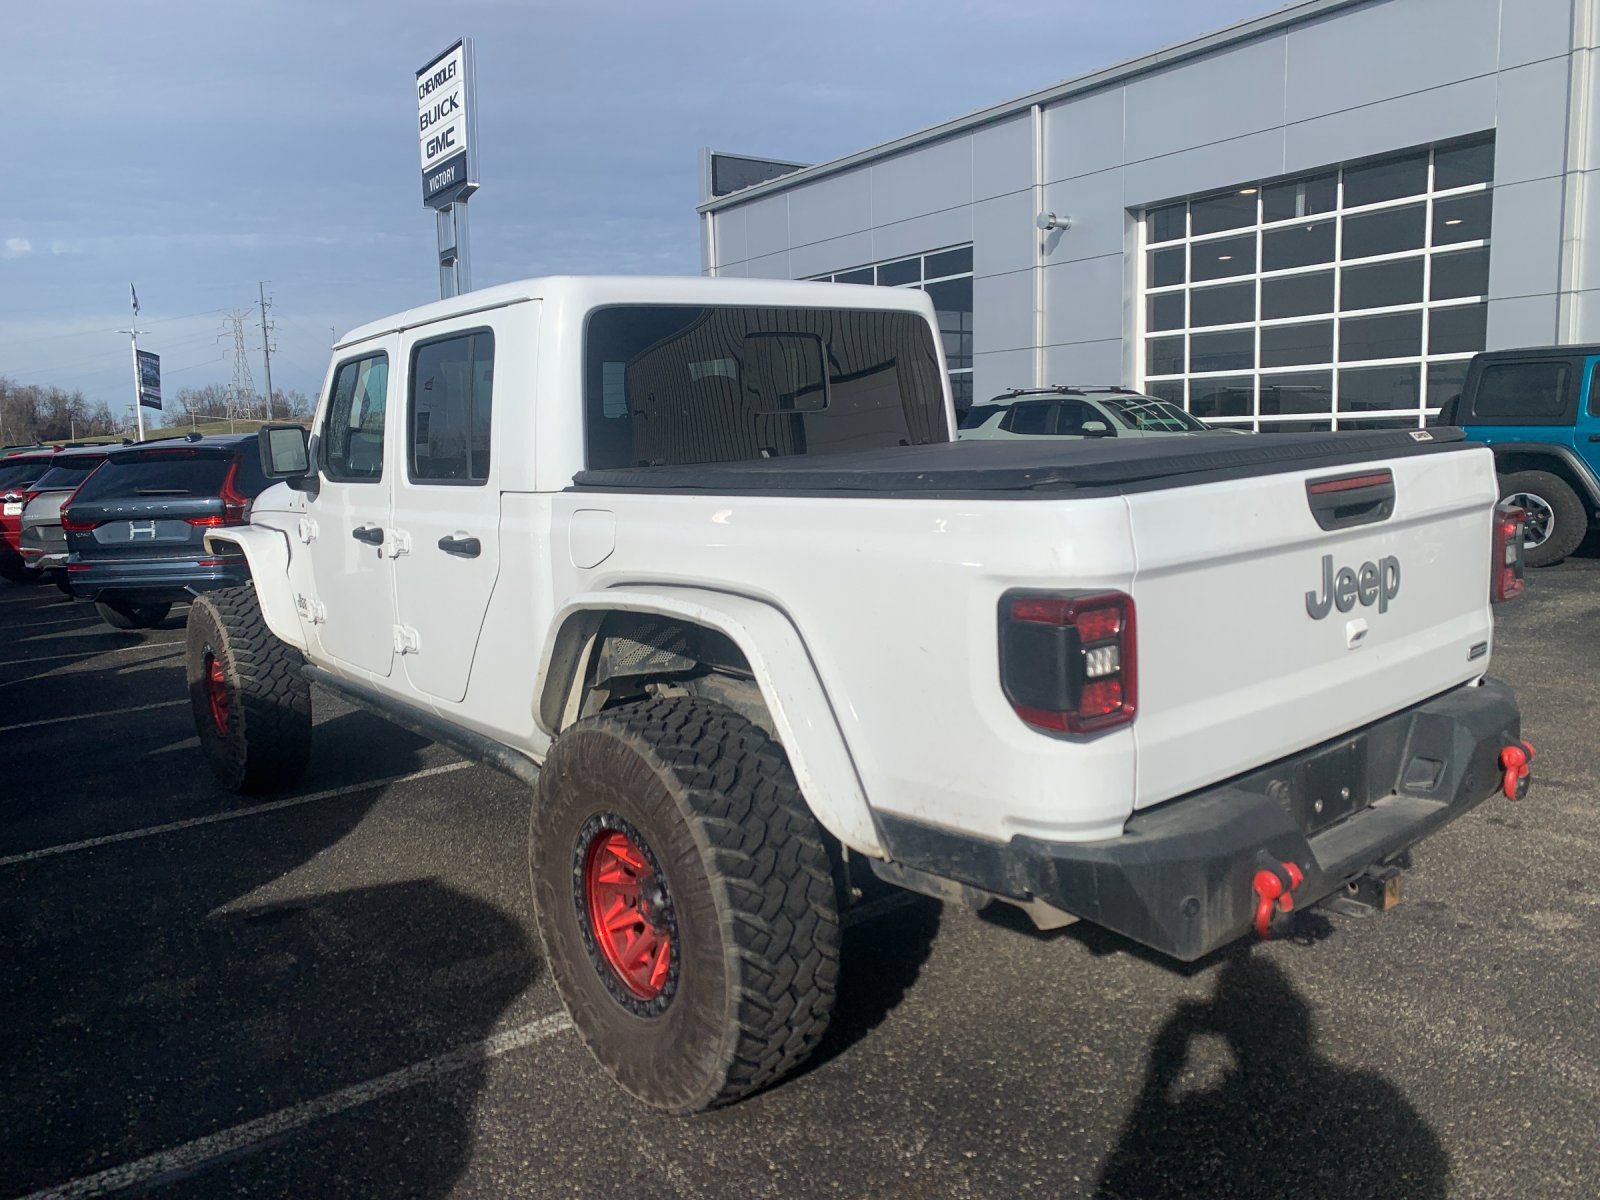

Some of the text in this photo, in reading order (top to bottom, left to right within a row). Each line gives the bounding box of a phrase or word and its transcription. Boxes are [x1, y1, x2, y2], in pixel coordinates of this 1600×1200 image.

[419, 60, 457, 100] CHEVROLET
[420, 91, 460, 131] BUICK
[426, 126, 455, 159] GMC
[429, 166, 456, 192] VICTORY
[1305, 554, 1401, 620] Jeep
